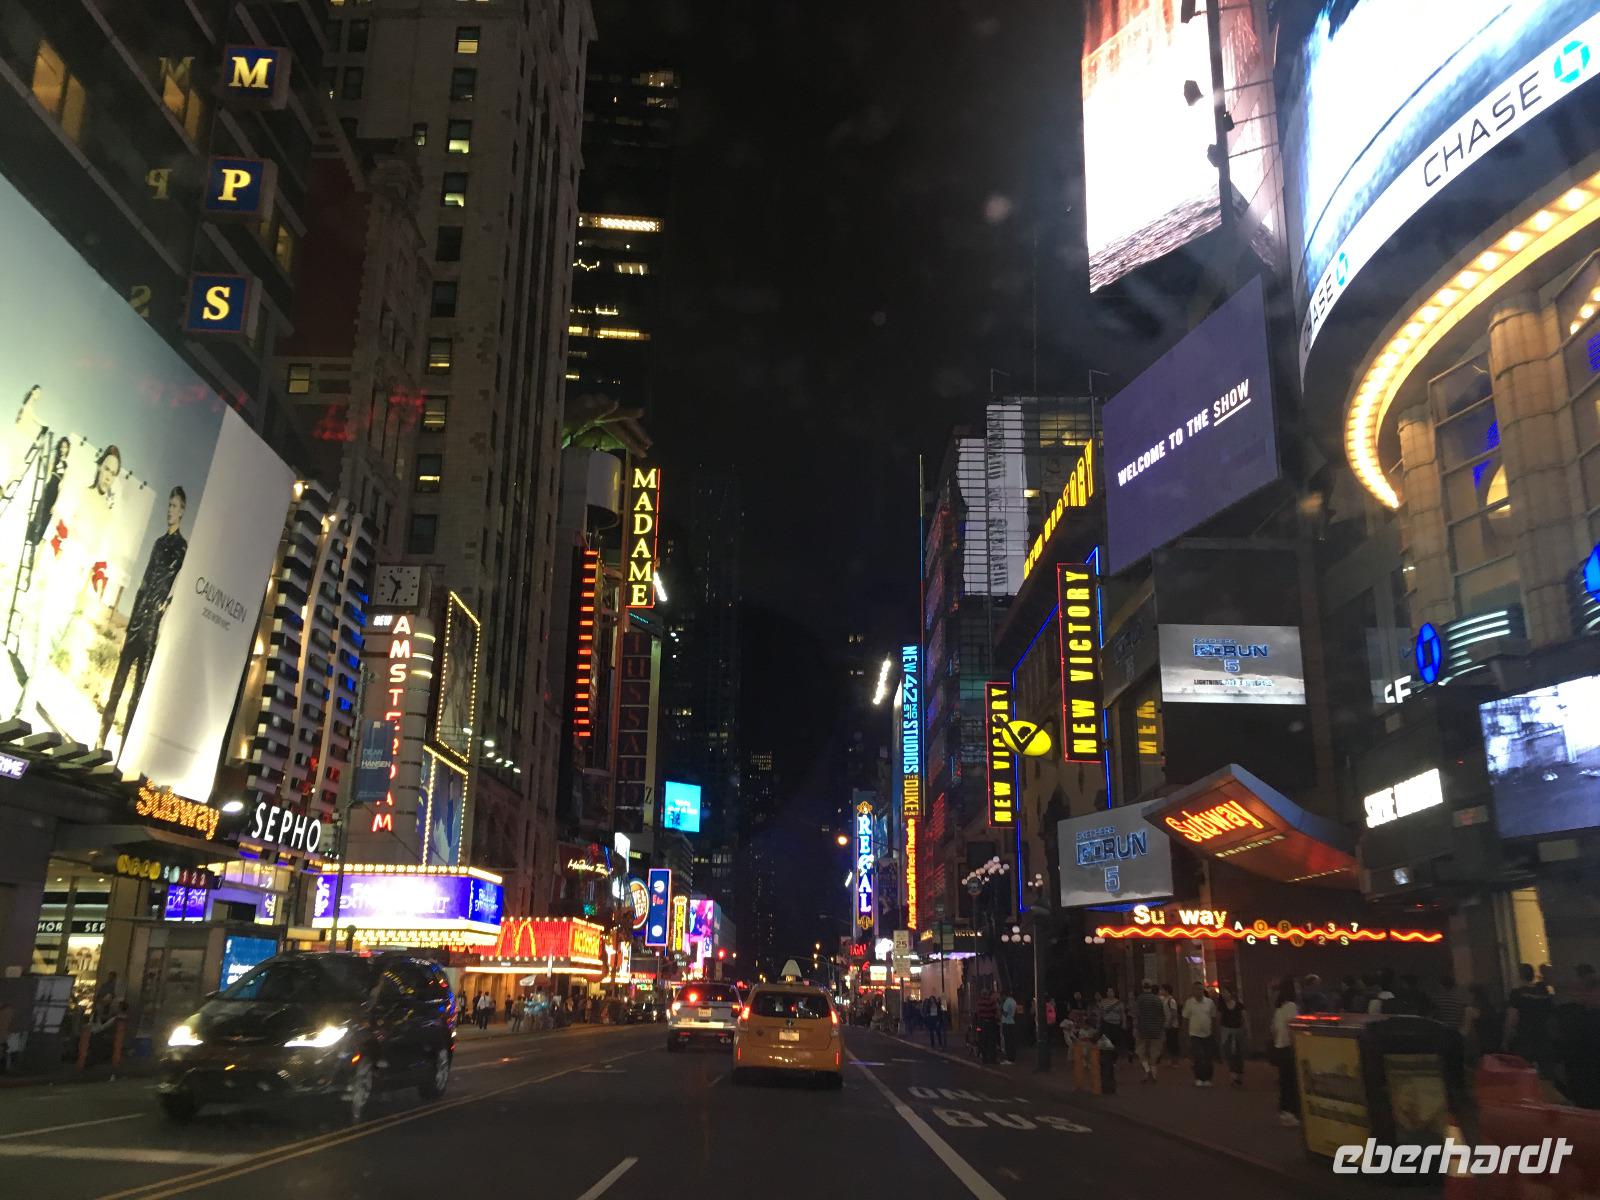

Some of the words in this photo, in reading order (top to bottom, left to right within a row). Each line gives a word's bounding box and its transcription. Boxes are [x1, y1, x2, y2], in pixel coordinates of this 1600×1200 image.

[1424, 71, 1542, 187] CHASE
[1118, 440, 1165, 487] WELCOME
[1168, 428, 1184, 450] TO
[1186, 408, 1210, 437] THE
[1213, 378, 1249, 419] SHOW
[628, 468, 657, 606] MADAME
[1065, 571, 1094, 682] VICTORY
[903, 645, 917, 673] NEW
[1223, 659, 1240, 673] 5
[904, 720, 918, 774] STUDIOS
[1072, 699, 1097, 754] NEW
[136, 777, 220, 841] Subway
[904, 779, 919, 811] DUKE
[994, 781, 1012, 822] NEW
[1165, 800, 1264, 842] Subway
[857, 814, 874, 913] REGAL
[1104, 865, 1121, 893] 5
[895, 940, 908, 949] 25
[1234, 920, 1244, 931] A
[1327, 922, 1336, 932] 3
[1350, 922, 1359, 932] 7
[1246, 934, 1257, 945] C
[1269, 934, 1279, 945] E
[1318, 935, 1326, 945] 2
[1340, 935, 1350, 946] S
[932, 1105, 1093, 1132] BUS
